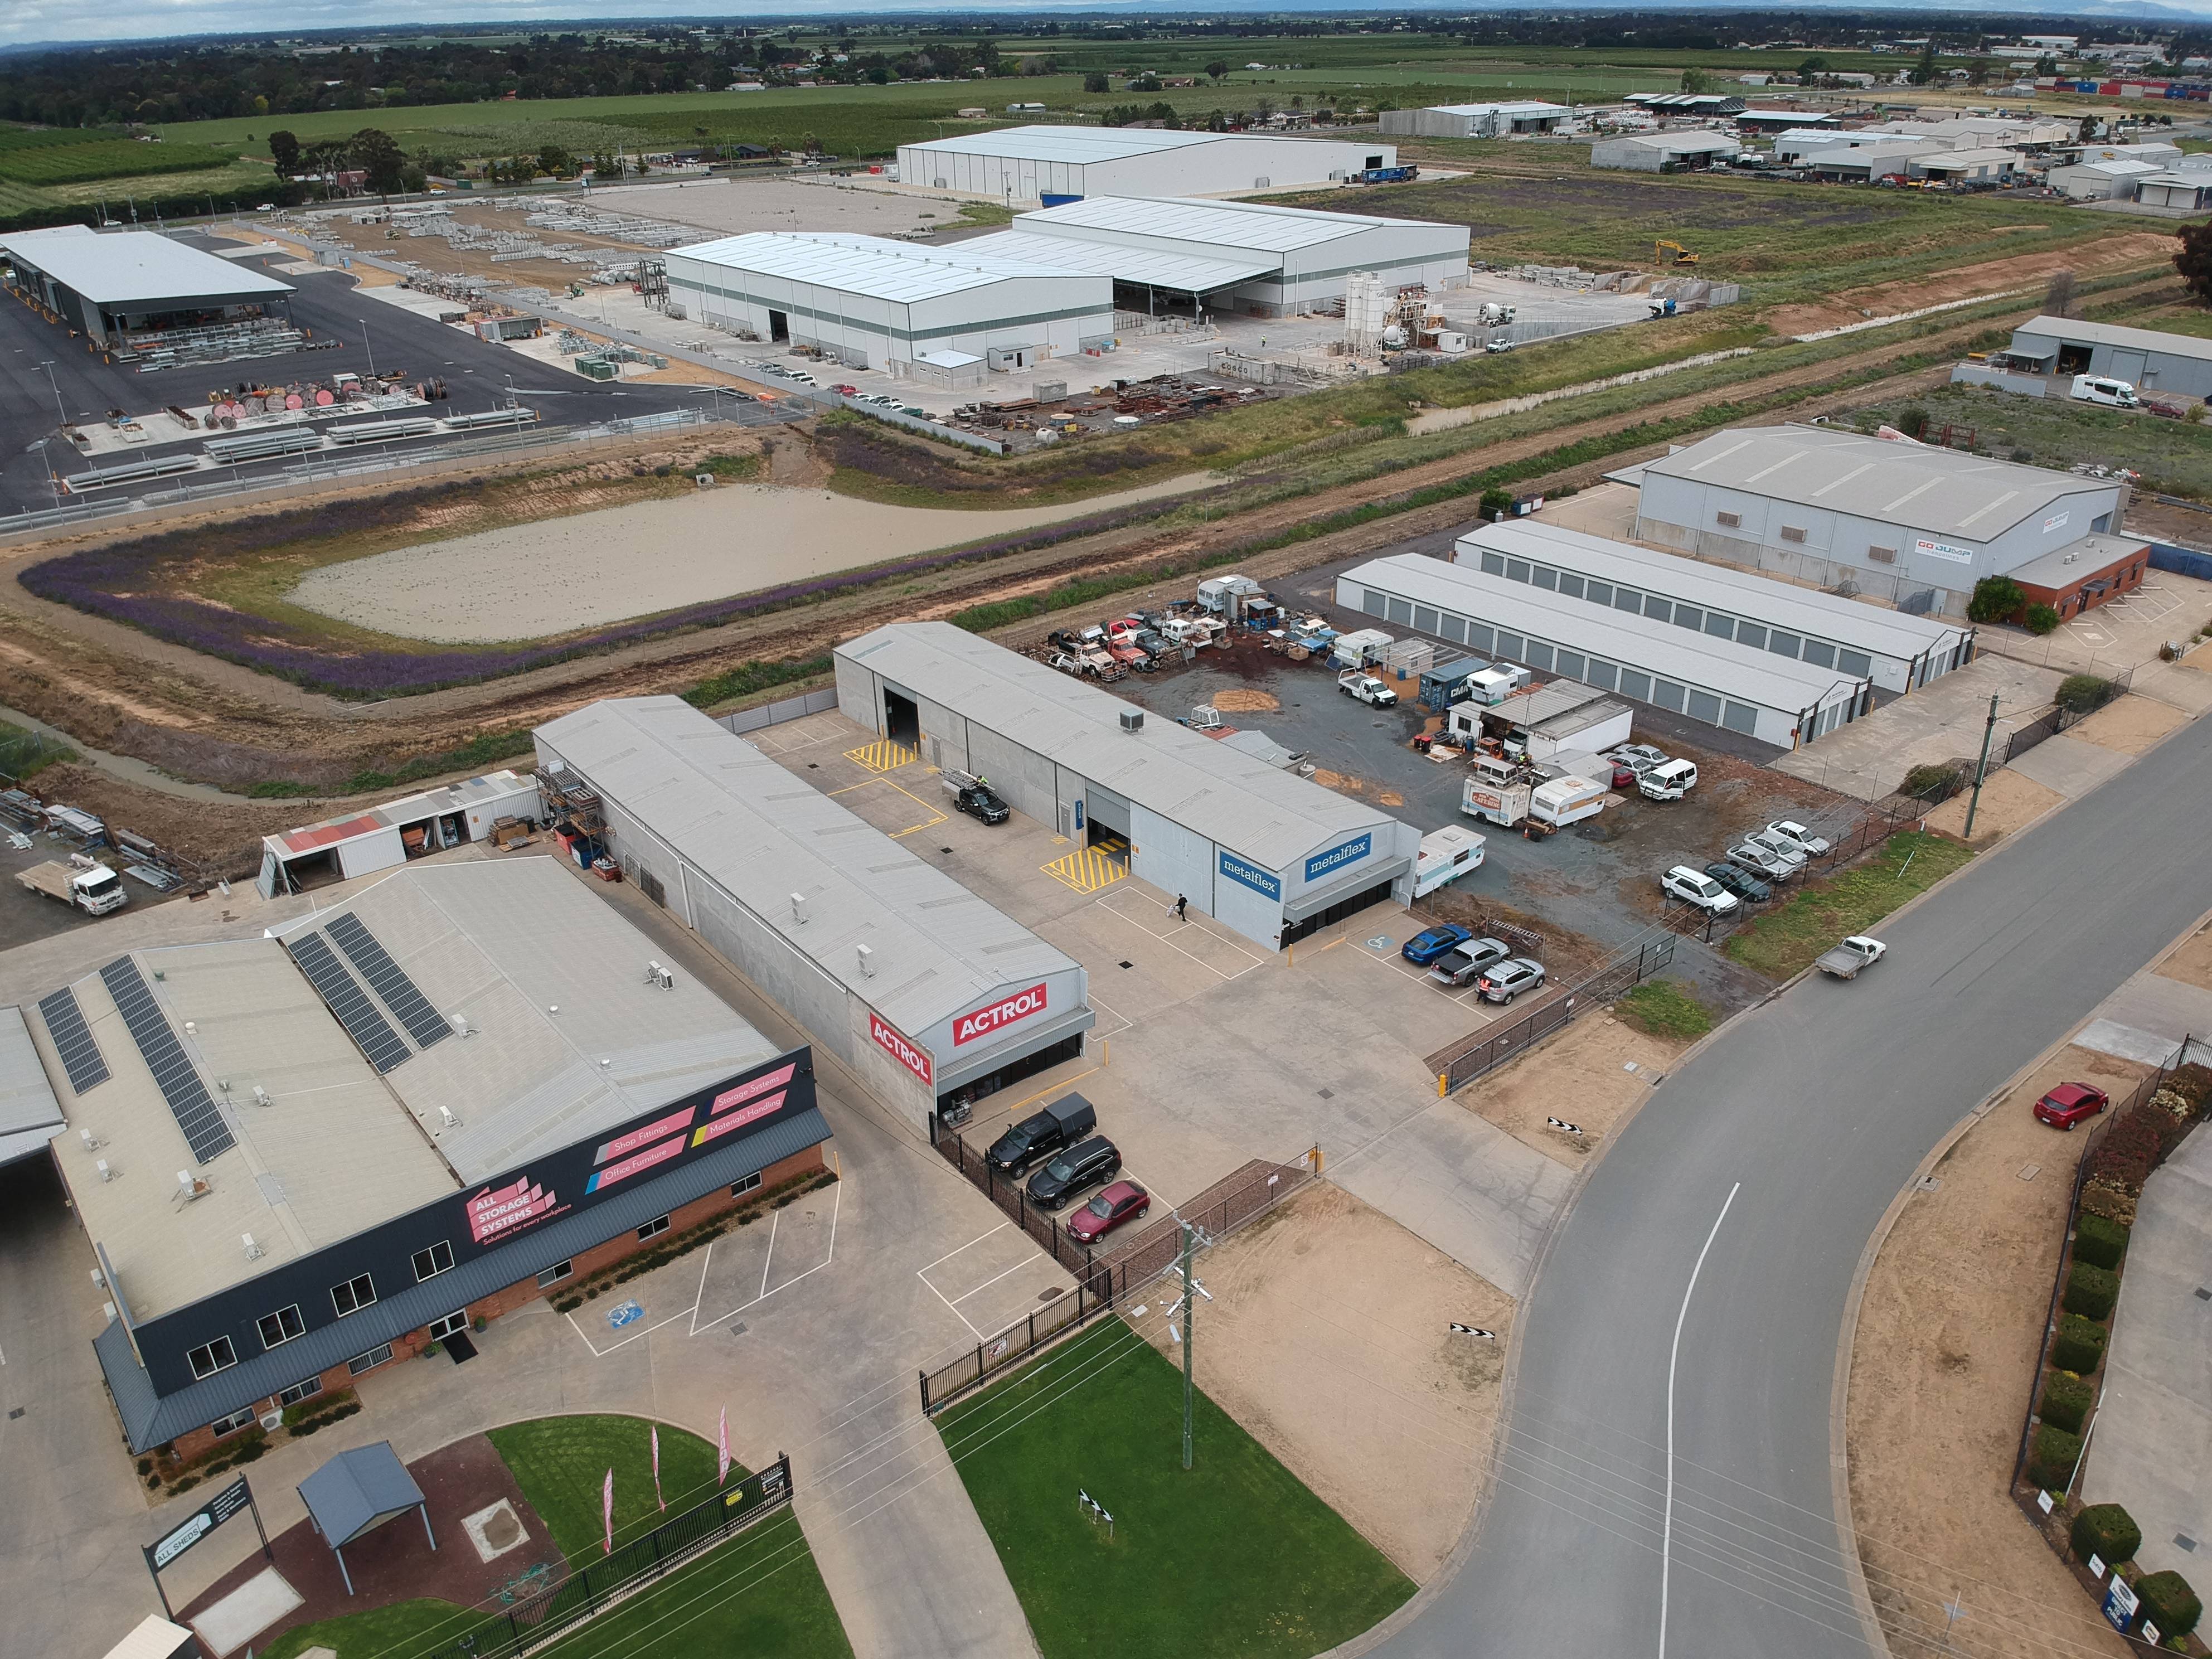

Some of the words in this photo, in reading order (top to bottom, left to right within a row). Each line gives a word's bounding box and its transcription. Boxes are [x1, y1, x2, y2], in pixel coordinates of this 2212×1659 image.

[1221, 362, 1248, 373] COSCO
[1927, 550, 1959, 560] Trampolines
[1936, 545, 1970, 556] JUMP
[1473, 795, 1500, 808] CATERING
[1310, 841, 1366, 874] metalflex
[1224, 860, 1275, 892] metalflex
[959, 991, 1042, 1040] ACTROL
[874, 1022, 928, 1079] ACTROL
[718, 1090, 748, 1107] Storage
[750, 1076, 780, 1093] Systems
[710, 1114, 746, 1134] Materials
[747, 1099, 781, 1117] Handling
[615, 1138, 636, 1151] Shop
[638, 1124, 668, 1140] Fittings
[605, 1166, 630, 1180] Office
[632, 1149, 667, 1168] Furniture
[476, 1196, 497, 1211] ALL
[478, 1195, 530, 1223] STORAGE
[481, 1207, 532, 1235] SYSTEMS
[483, 1229, 512, 1245] Solutions
[523, 1217, 540, 1228] every
[541, 1204, 572, 1220] workplace
[158, 1550, 172, 1563] ALL
[173, 1528, 198, 1550] SHEDS
[2107, 1606, 2123, 1626] PUBLIC
[2114, 1606, 2120, 1616] TO
